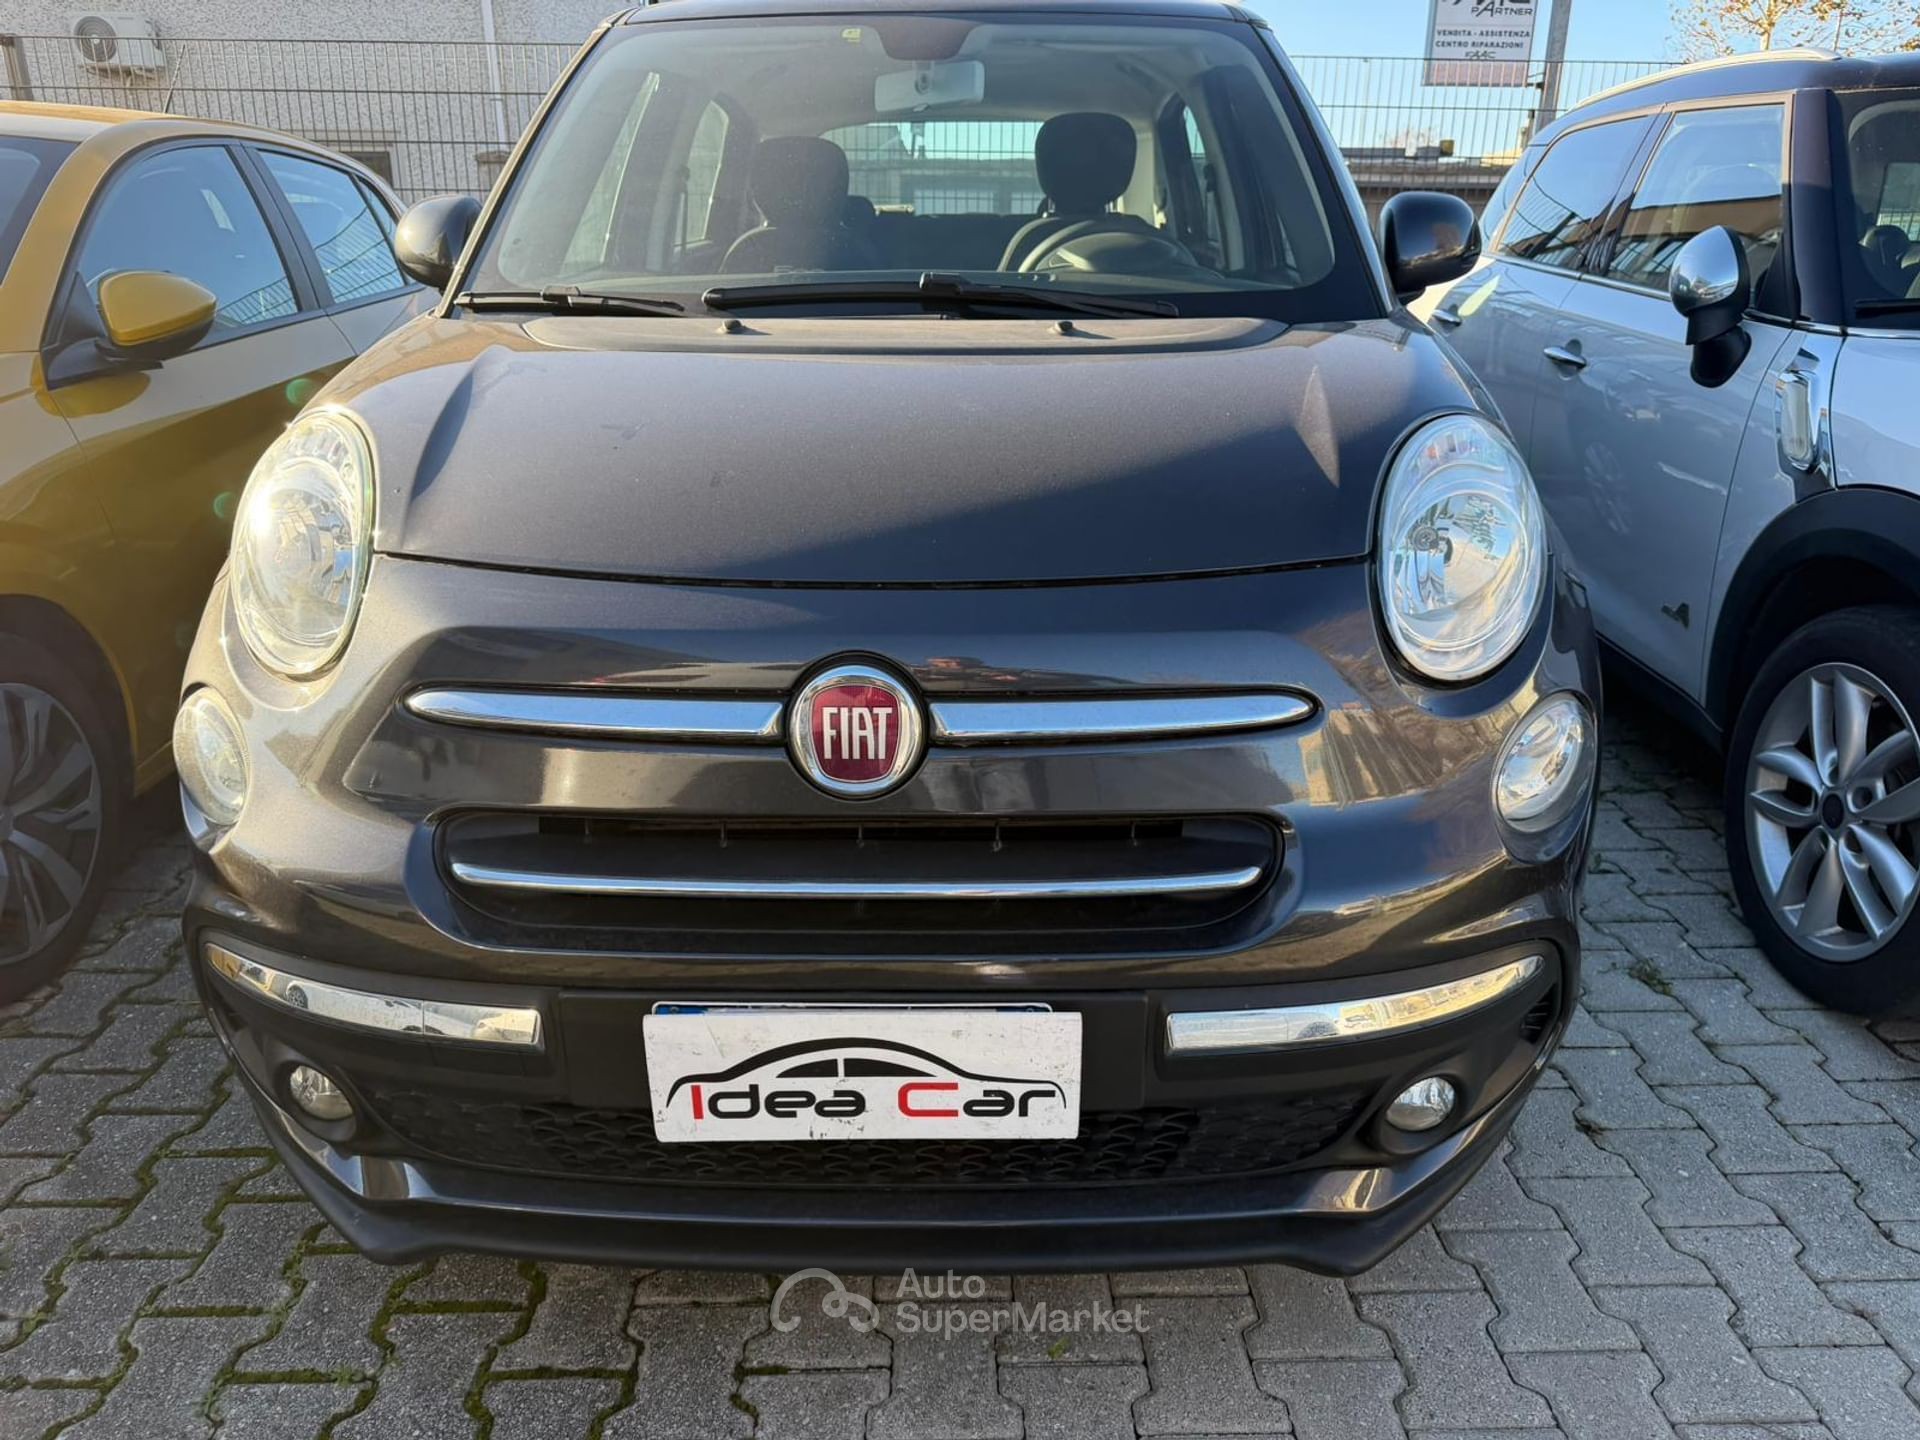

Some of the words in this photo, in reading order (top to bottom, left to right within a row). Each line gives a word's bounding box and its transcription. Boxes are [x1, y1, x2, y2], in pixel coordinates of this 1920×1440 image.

[1471, 1, 1534, 17] PARTNER
[1436, 29, 1472, 37] VENDITA
[1479, 29, 1531, 38] ASSISTENZA
[1435, 40, 1469, 48] CENTRO
[1471, 41, 1524, 49] RIPARAZIONI
[822, 706, 893, 760] FIAT
[690, 1083, 866, 1120] Idea
[897, 1082, 1057, 1118] Car
